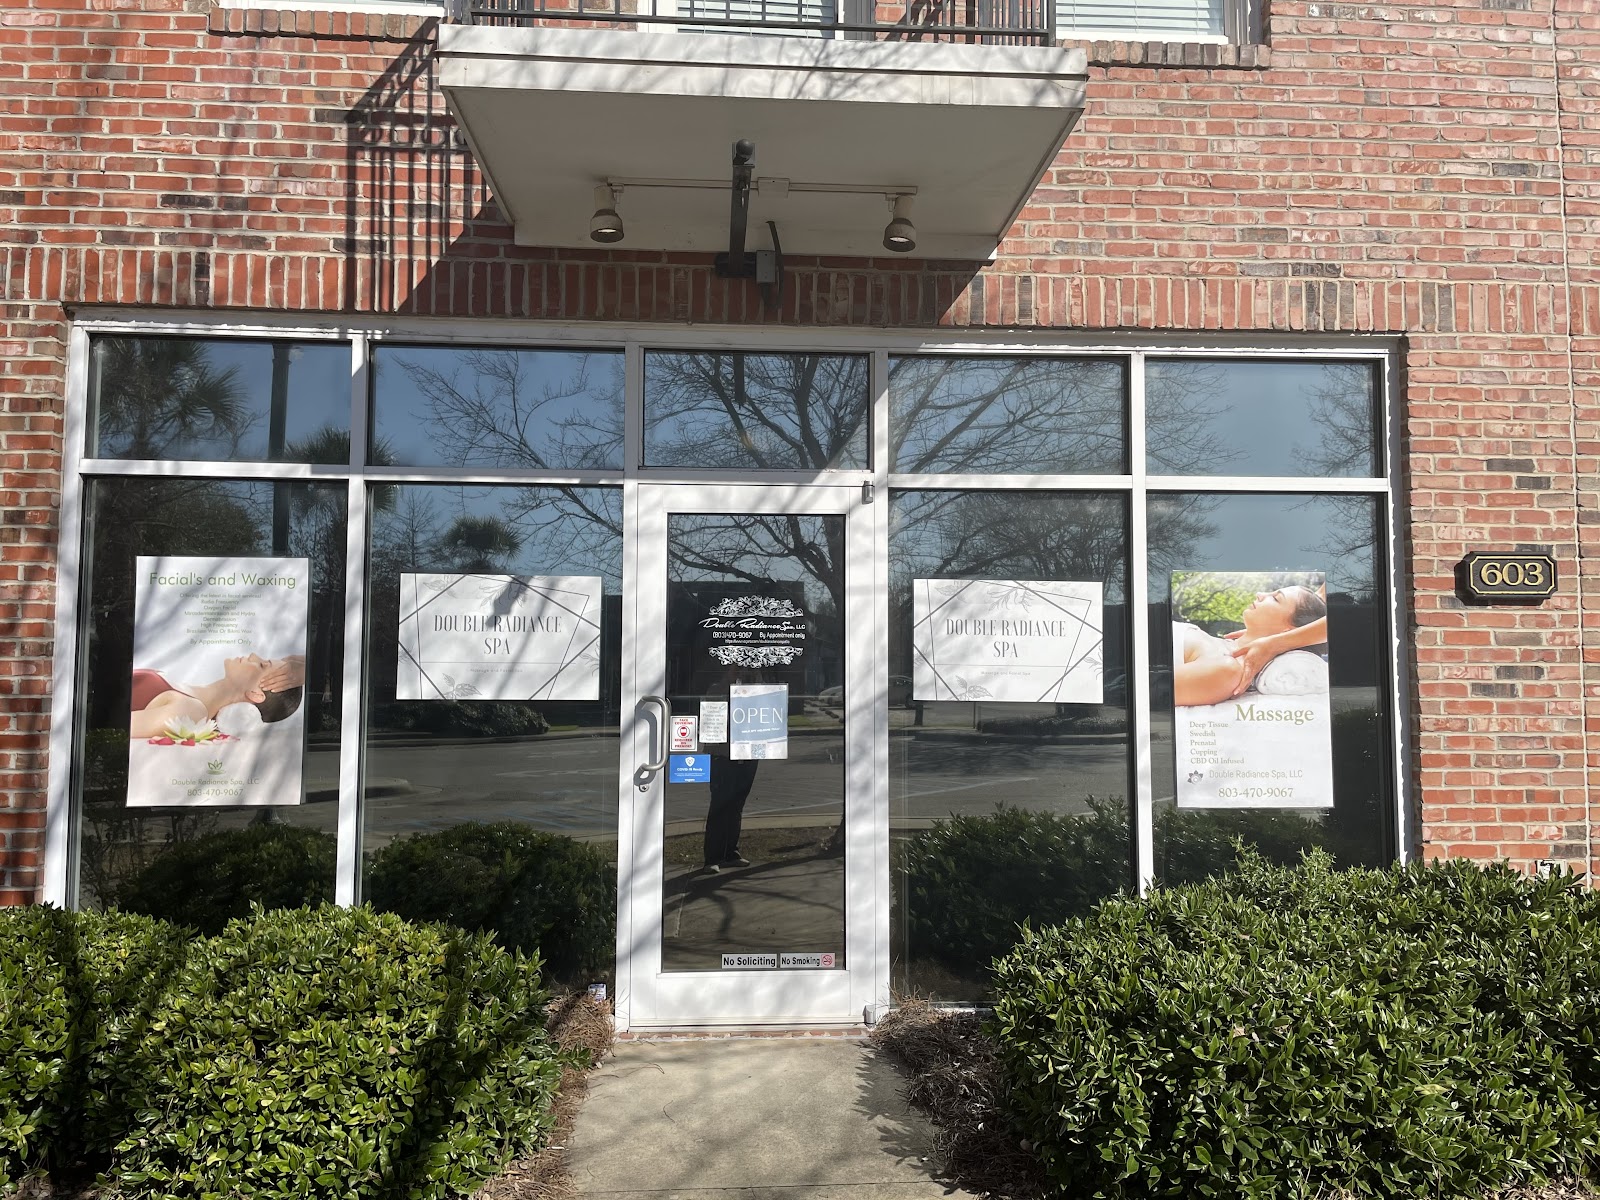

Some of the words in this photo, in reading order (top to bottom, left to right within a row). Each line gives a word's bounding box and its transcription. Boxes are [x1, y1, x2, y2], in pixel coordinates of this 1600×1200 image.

[149, 572, 203, 586] Facial's
[207, 572, 236, 586] and
[241, 573, 296, 589] Waxing
[1480, 562, 1544, 586] 603
[434, 614, 489, 633] DOUBLE
[493, 615, 562, 633] RADIANCE
[698, 617, 736, 629] Double
[735, 617, 781, 630] Radiance
[946, 618, 997, 636] DOUBLE
[1001, 619, 1067, 637] RADIANCE
[759, 631, 766, 639] By
[766, 631, 795, 639] Appointment
[795, 632, 806, 640] only
[483, 637, 511, 655] SPA
[993, 641, 1019, 658] SPA
[732, 707, 783, 724] OPEN
[1235, 703, 1315, 726] Massage
[1189, 721, 1206, 729] Deep
[1190, 748, 1218, 757] Cupping
[1209, 770, 1234, 779] Double
[1235, 770, 1270, 779] Radiance
[1271, 770, 1288, 780] Spa,
[1289, 769, 1303, 778] LLC
[187, 789, 244, 797] 803-470-9067
[1218, 787, 1294, 798] 803-470-9067
[723, 957, 735, 966] No
[736, 956, 776, 967] Soliciting
[781, 956, 791, 965] No
[792, 956, 820, 967] Smoking
